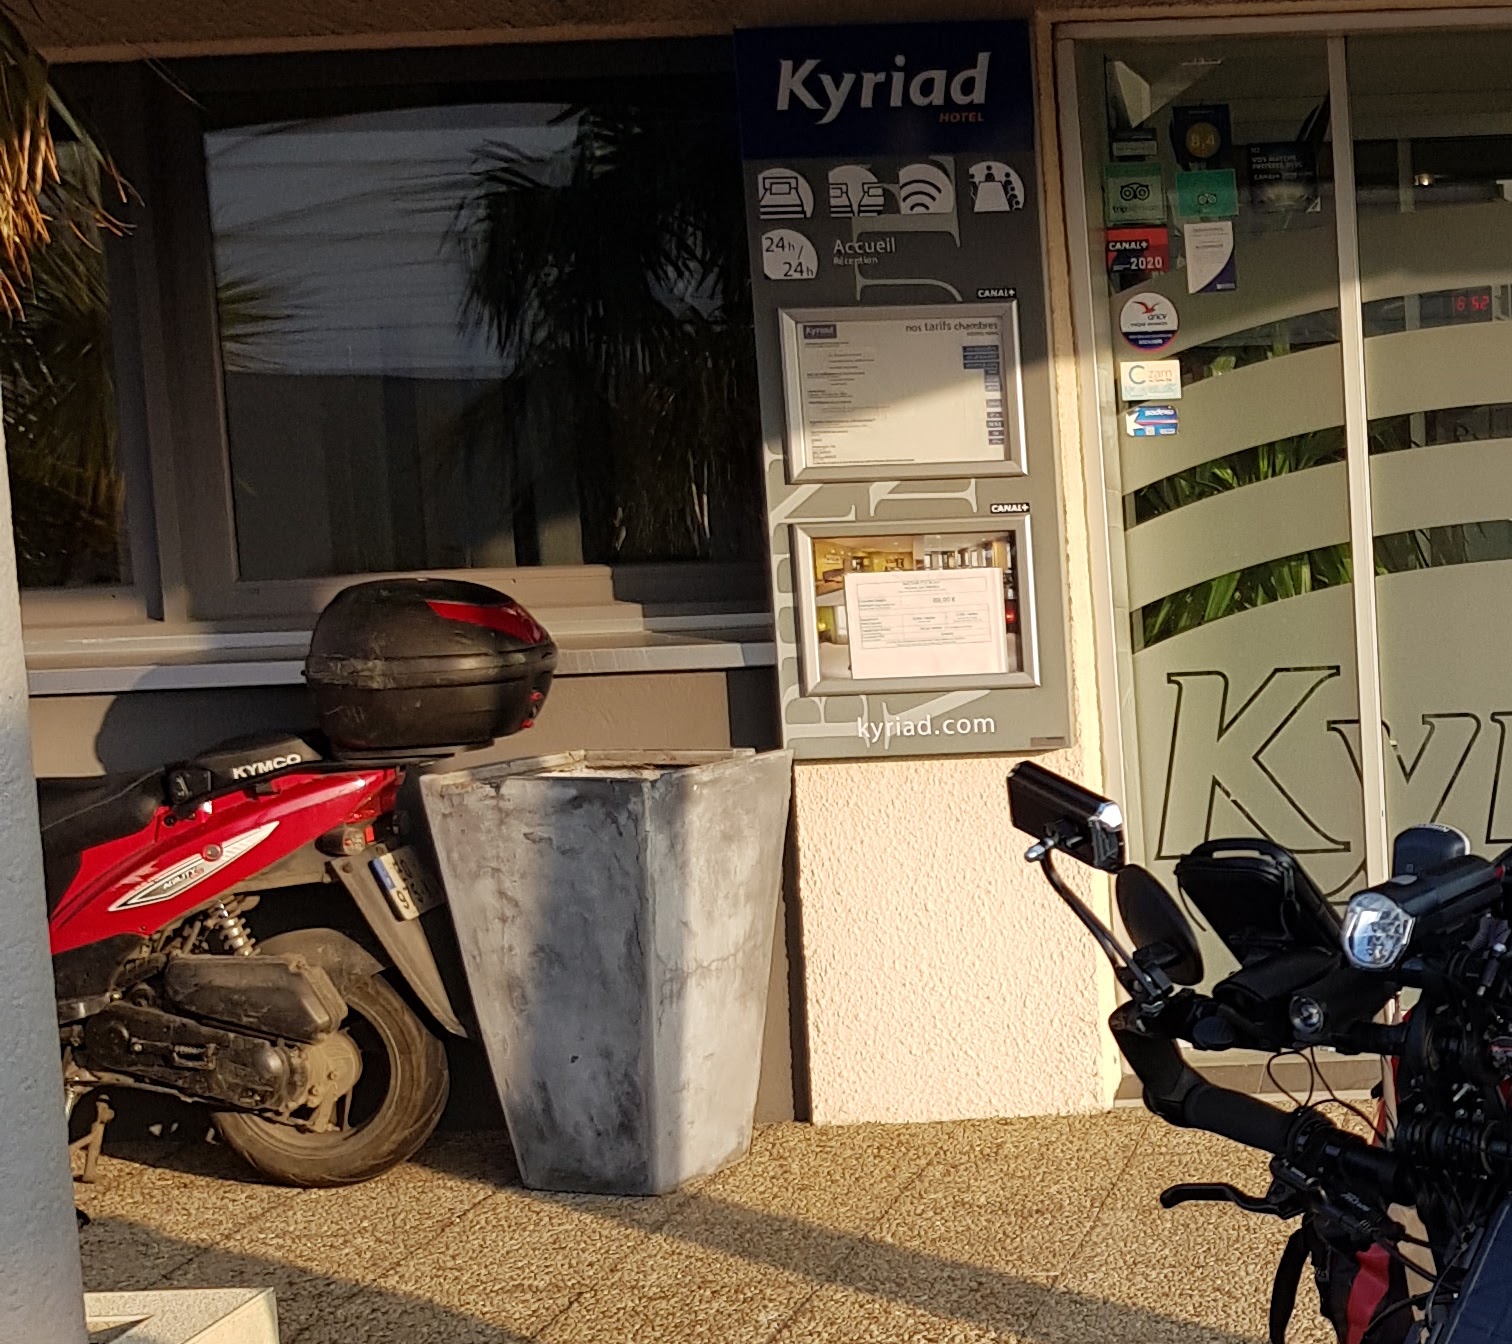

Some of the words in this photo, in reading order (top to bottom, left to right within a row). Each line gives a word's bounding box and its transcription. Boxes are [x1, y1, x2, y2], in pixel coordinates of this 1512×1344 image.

[776, 52, 992, 124] Kyriad
[938, 111, 985, 123] HOTEL
[833, 237, 896, 255] Accueil
[1108, 241, 1149, 251] CANAL+
[782, 261, 814, 277] 24h
[1130, 256, 1163, 270] 2020
[977, 288, 1016, 298] CANAL+
[905, 324, 922, 333] nos
[924, 322, 951, 332] tarifs
[954, 321, 998, 331] chambres
[990, 503, 1030, 513] CANAL+
[857, 714, 996, 744] kyriad.com
[232, 753, 302, 780] KYMCO
